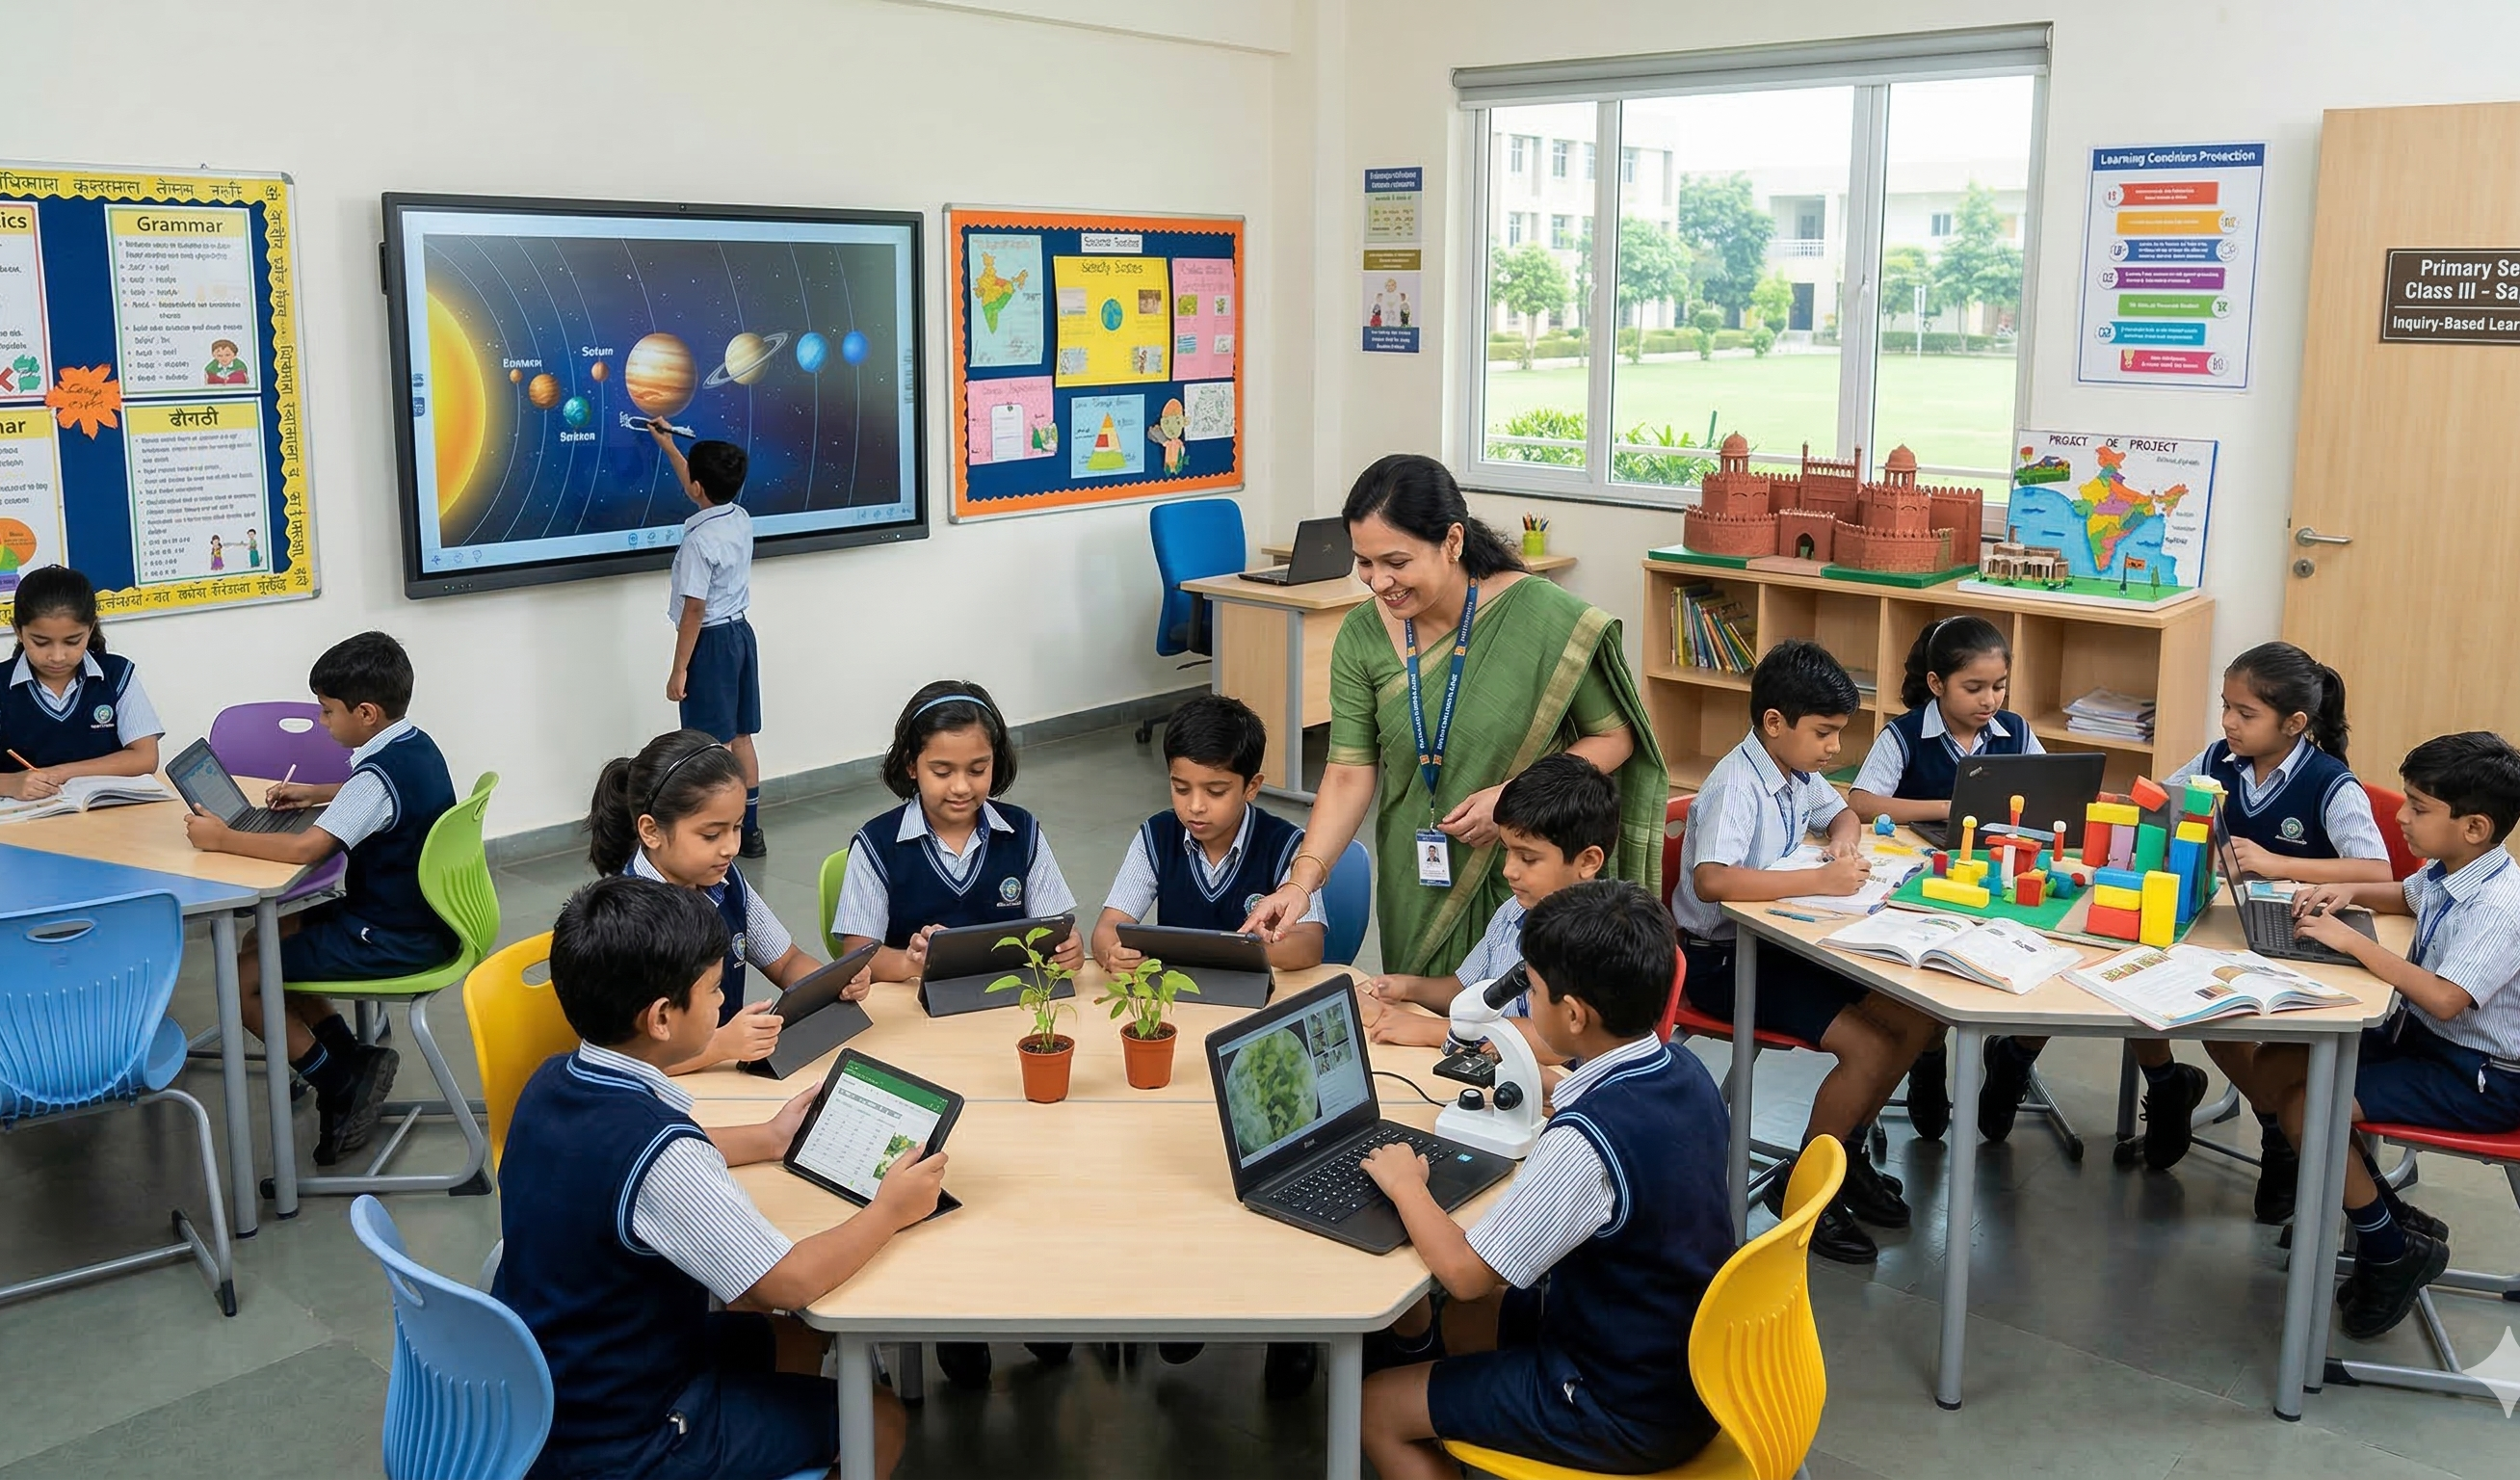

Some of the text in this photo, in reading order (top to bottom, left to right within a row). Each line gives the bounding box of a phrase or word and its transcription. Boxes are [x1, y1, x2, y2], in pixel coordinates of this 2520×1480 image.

[0, 211, 27, 229] ics
[137, 216, 223, 233] Grammar
[2421, 259, 2492, 280] Primary
[2405, 281, 2454, 300] Class
[2458, 282, 2477, 300] III
[2495, 282, 2520, 304] Sa
[2393, 315, 2485, 332] Inquiry-Based
[2130, 439, 2179, 453] PROJECT
